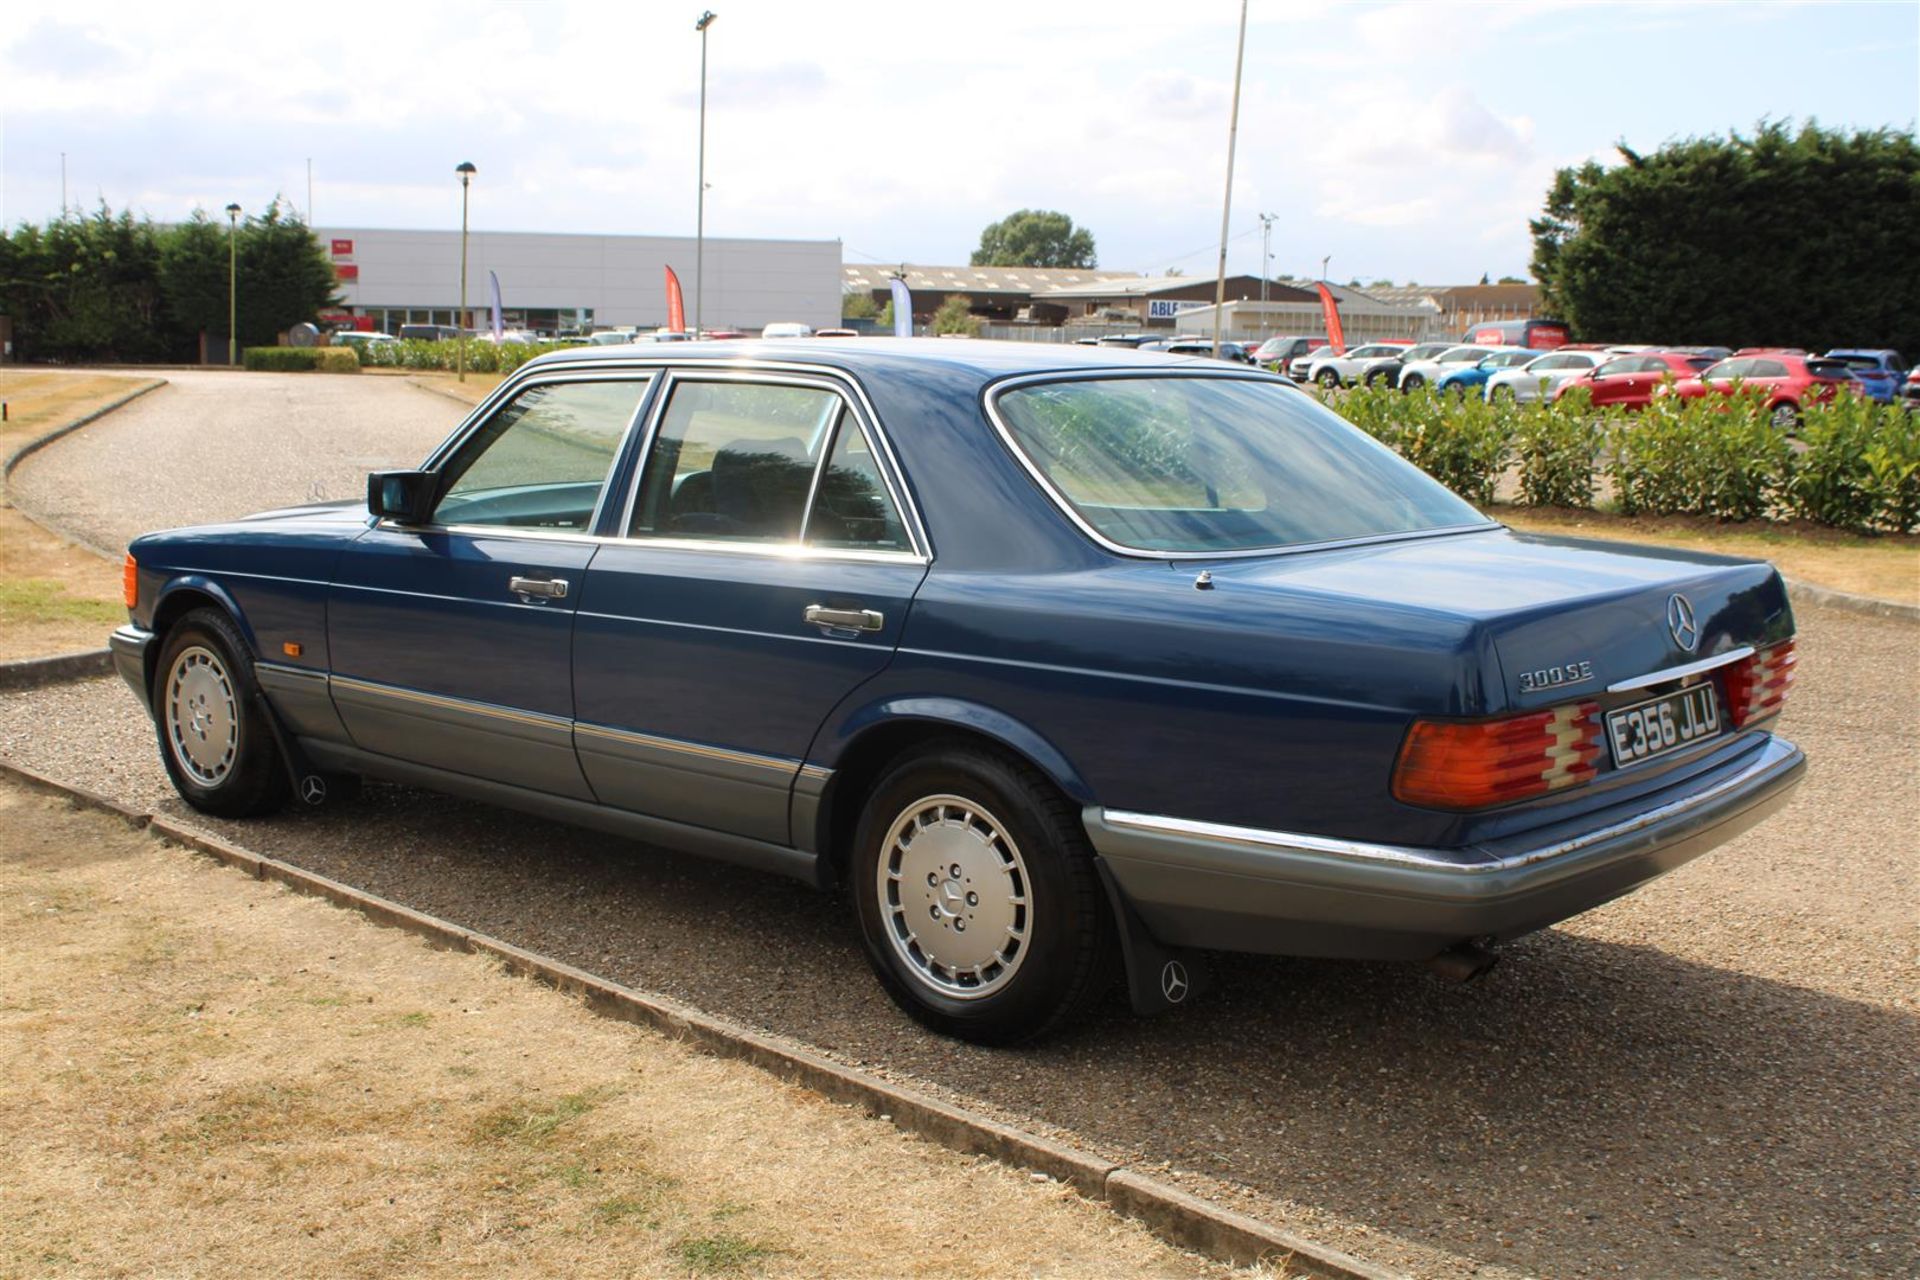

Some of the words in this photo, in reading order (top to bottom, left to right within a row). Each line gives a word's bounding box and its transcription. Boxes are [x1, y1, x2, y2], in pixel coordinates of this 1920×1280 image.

[1519, 667, 1563, 691] 300
[1566, 660, 1593, 680] SE
[1611, 702, 1676, 762] E356
[1680, 688, 1717, 740] JLU
